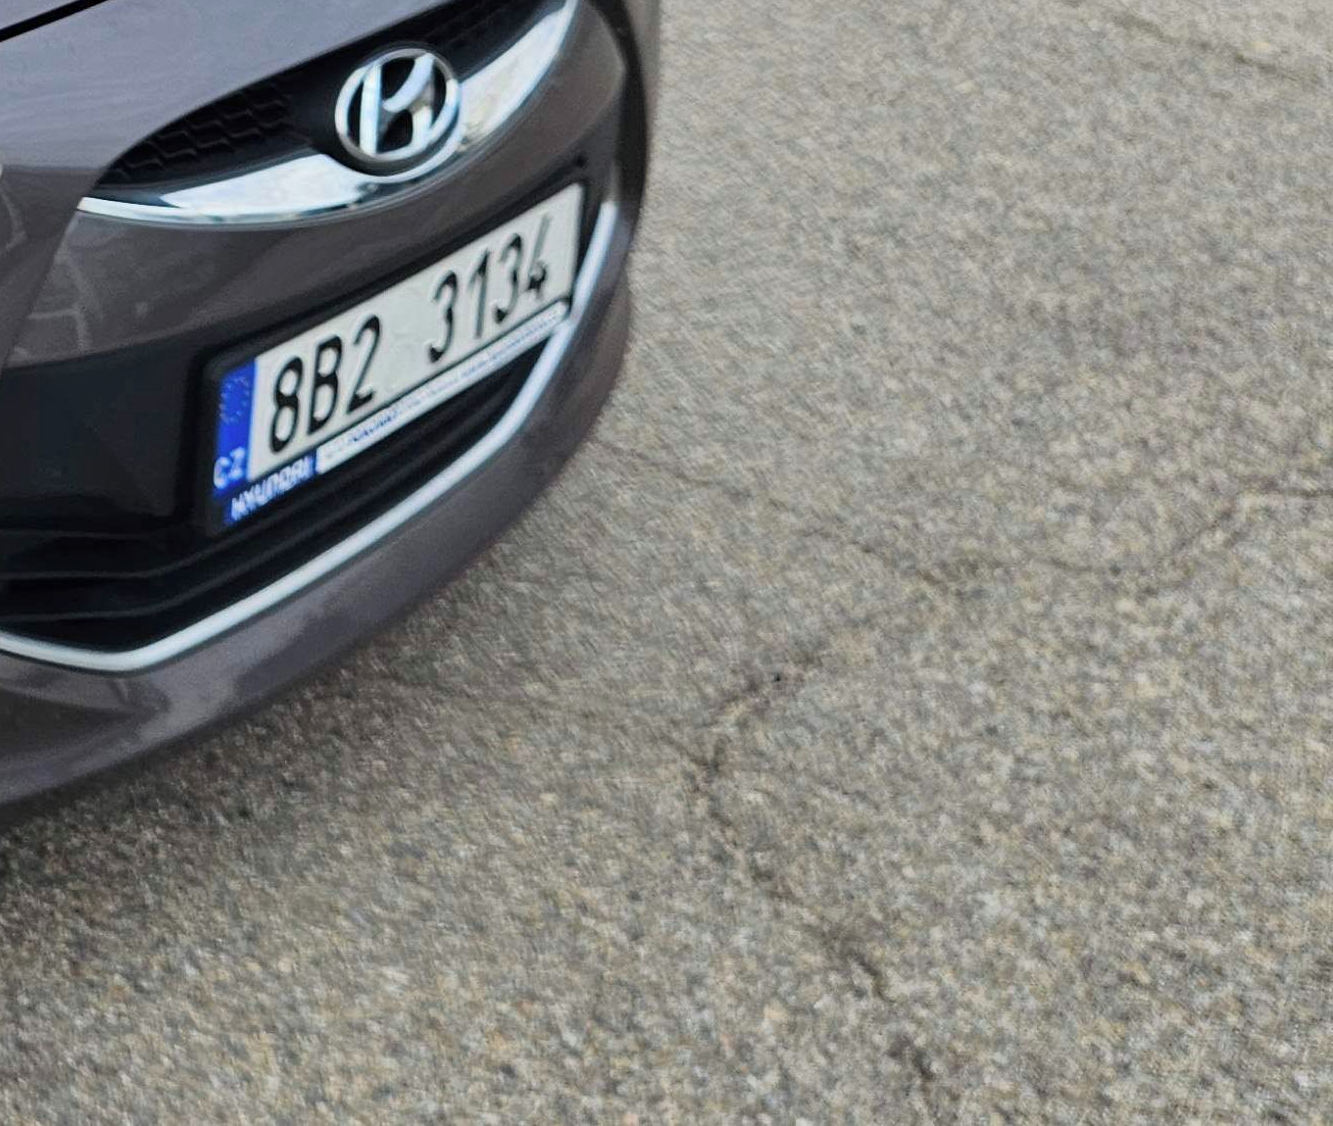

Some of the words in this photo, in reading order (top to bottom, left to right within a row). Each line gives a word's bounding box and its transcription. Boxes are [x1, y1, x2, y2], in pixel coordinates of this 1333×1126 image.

[269, 314, 381, 453] 8B2
[427, 214, 552, 364] 3134
[213, 446, 246, 490] CZ
[231, 455, 311, 521] HYUNDAI
